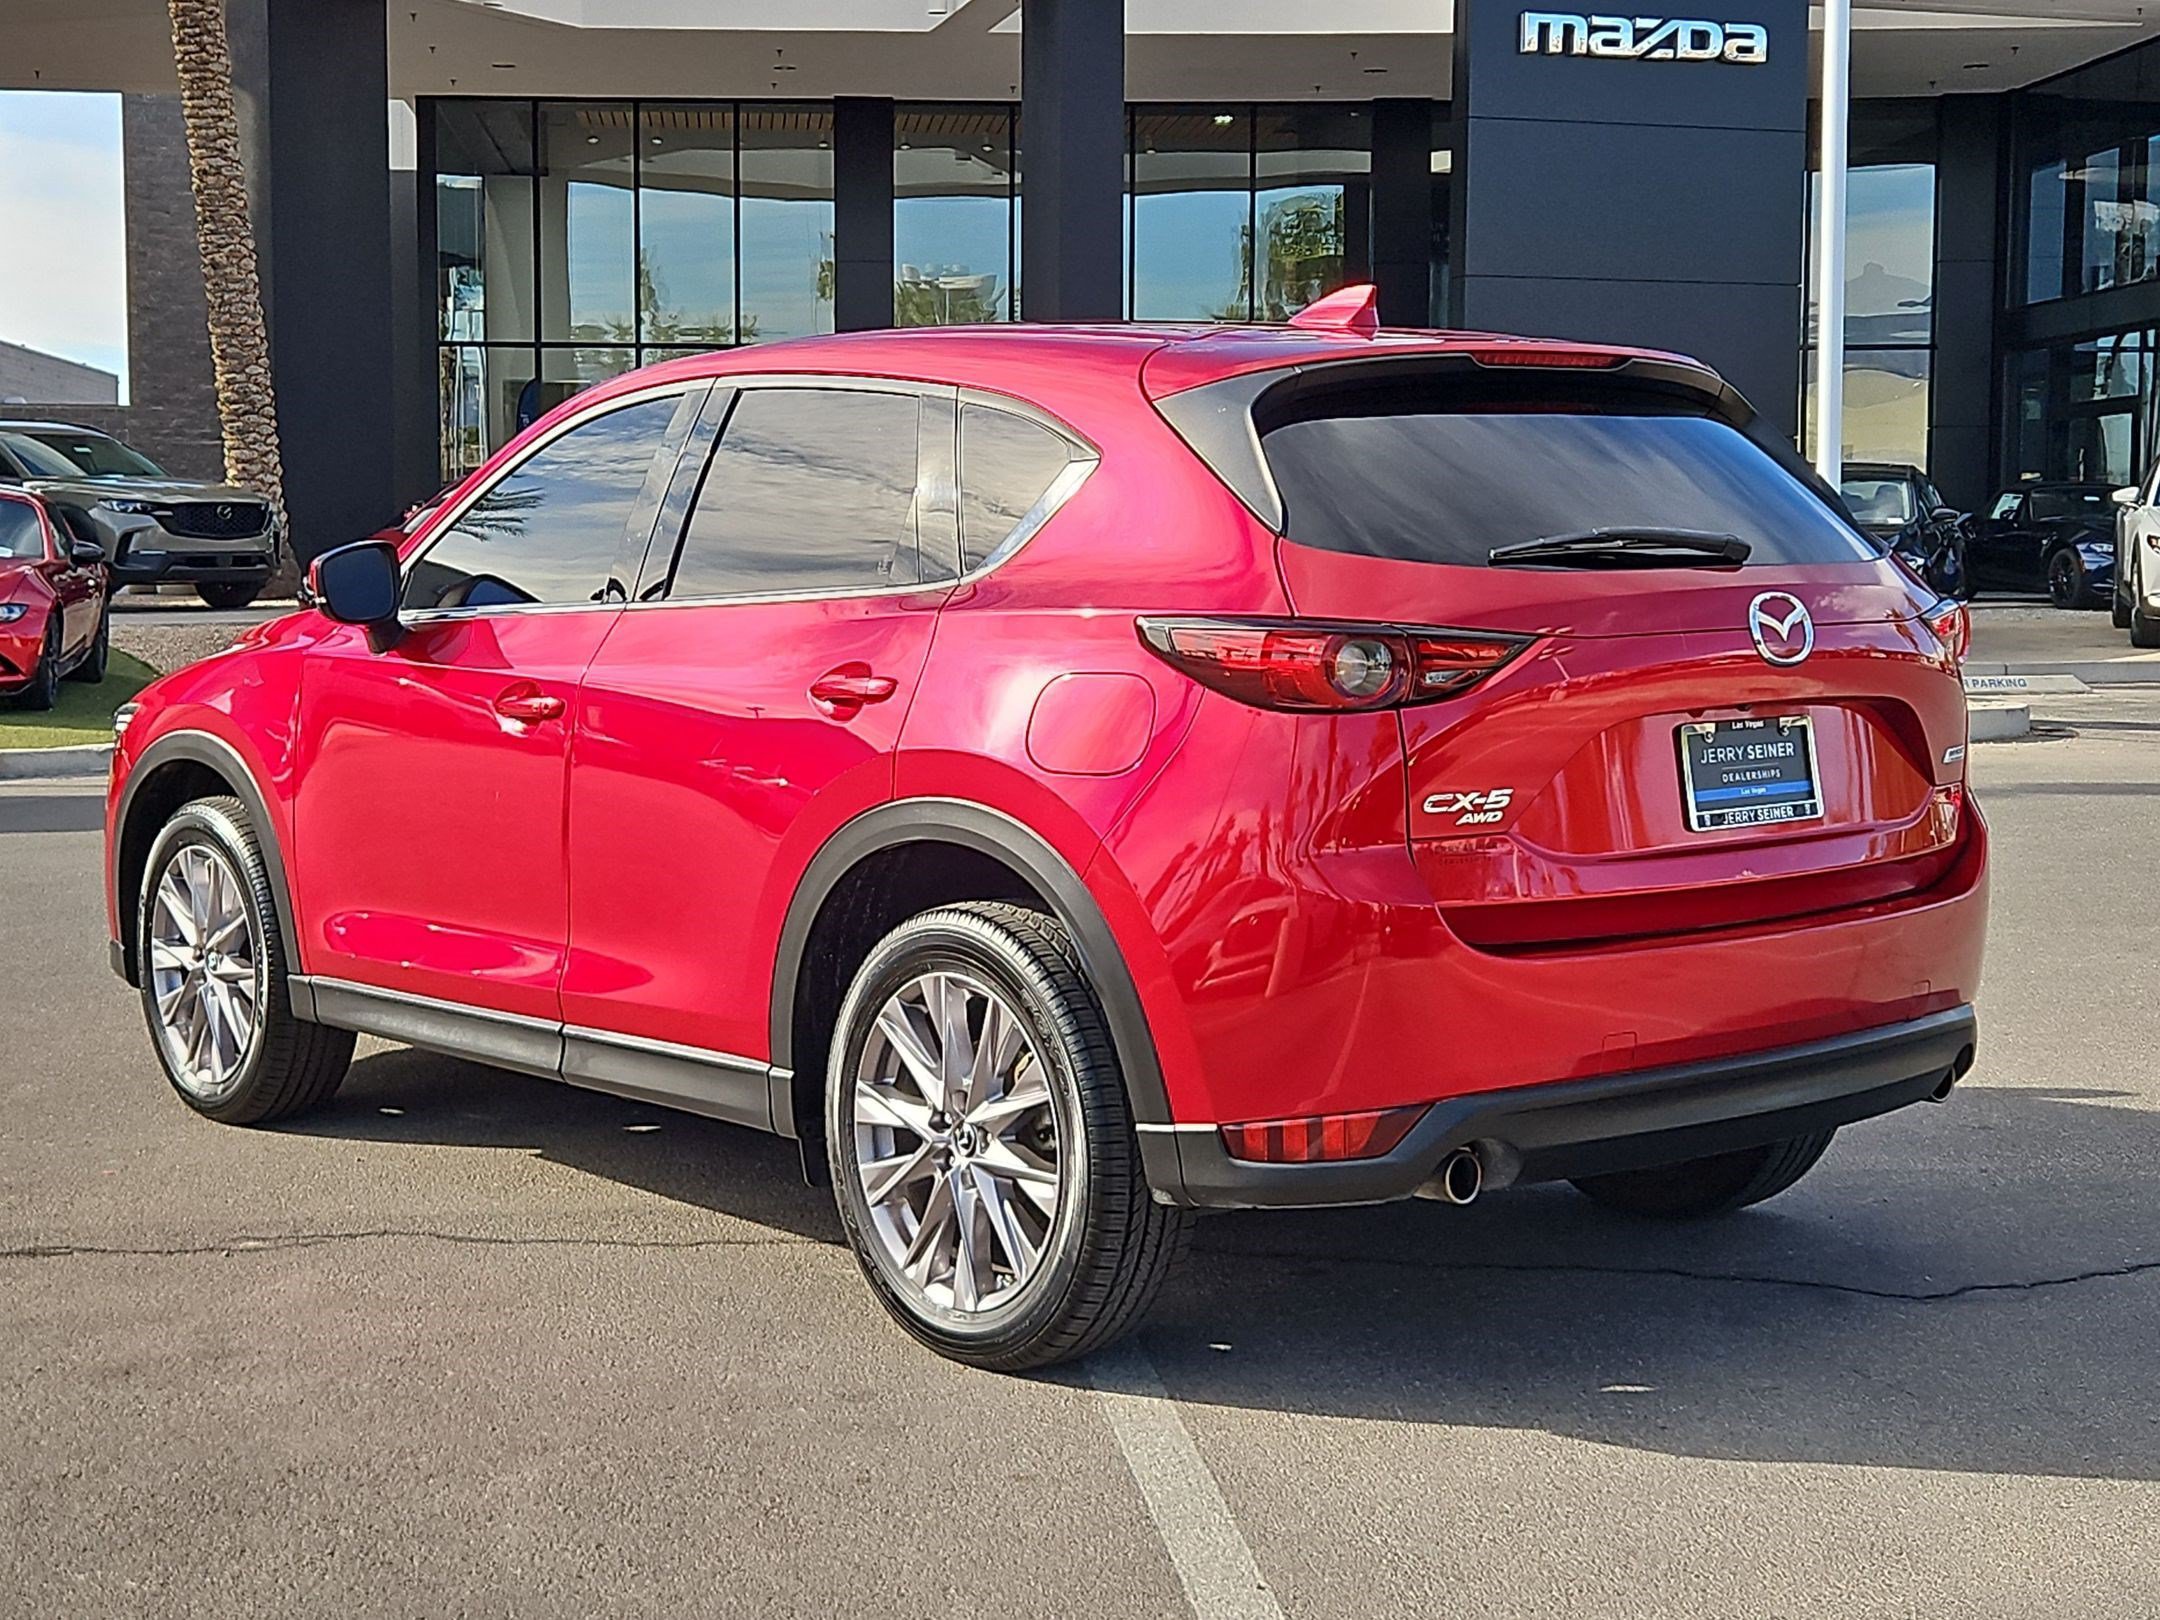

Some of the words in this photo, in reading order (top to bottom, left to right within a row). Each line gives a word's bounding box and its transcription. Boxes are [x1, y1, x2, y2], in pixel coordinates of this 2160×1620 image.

[1971, 678, 2027, 688] PARKING
[1732, 721, 1745, 729] Las
[1701, 747, 1744, 764] JERRY
[1748, 743, 1794, 759] SEINER
[1722, 769, 1781, 783] DEALERSHIPS
[1423, 788, 1514, 813] CX-5
[1455, 811, 1504, 826] AWD
[1723, 809, 1756, 825] JERRY
[1757, 806, 1795, 821] SEINER
